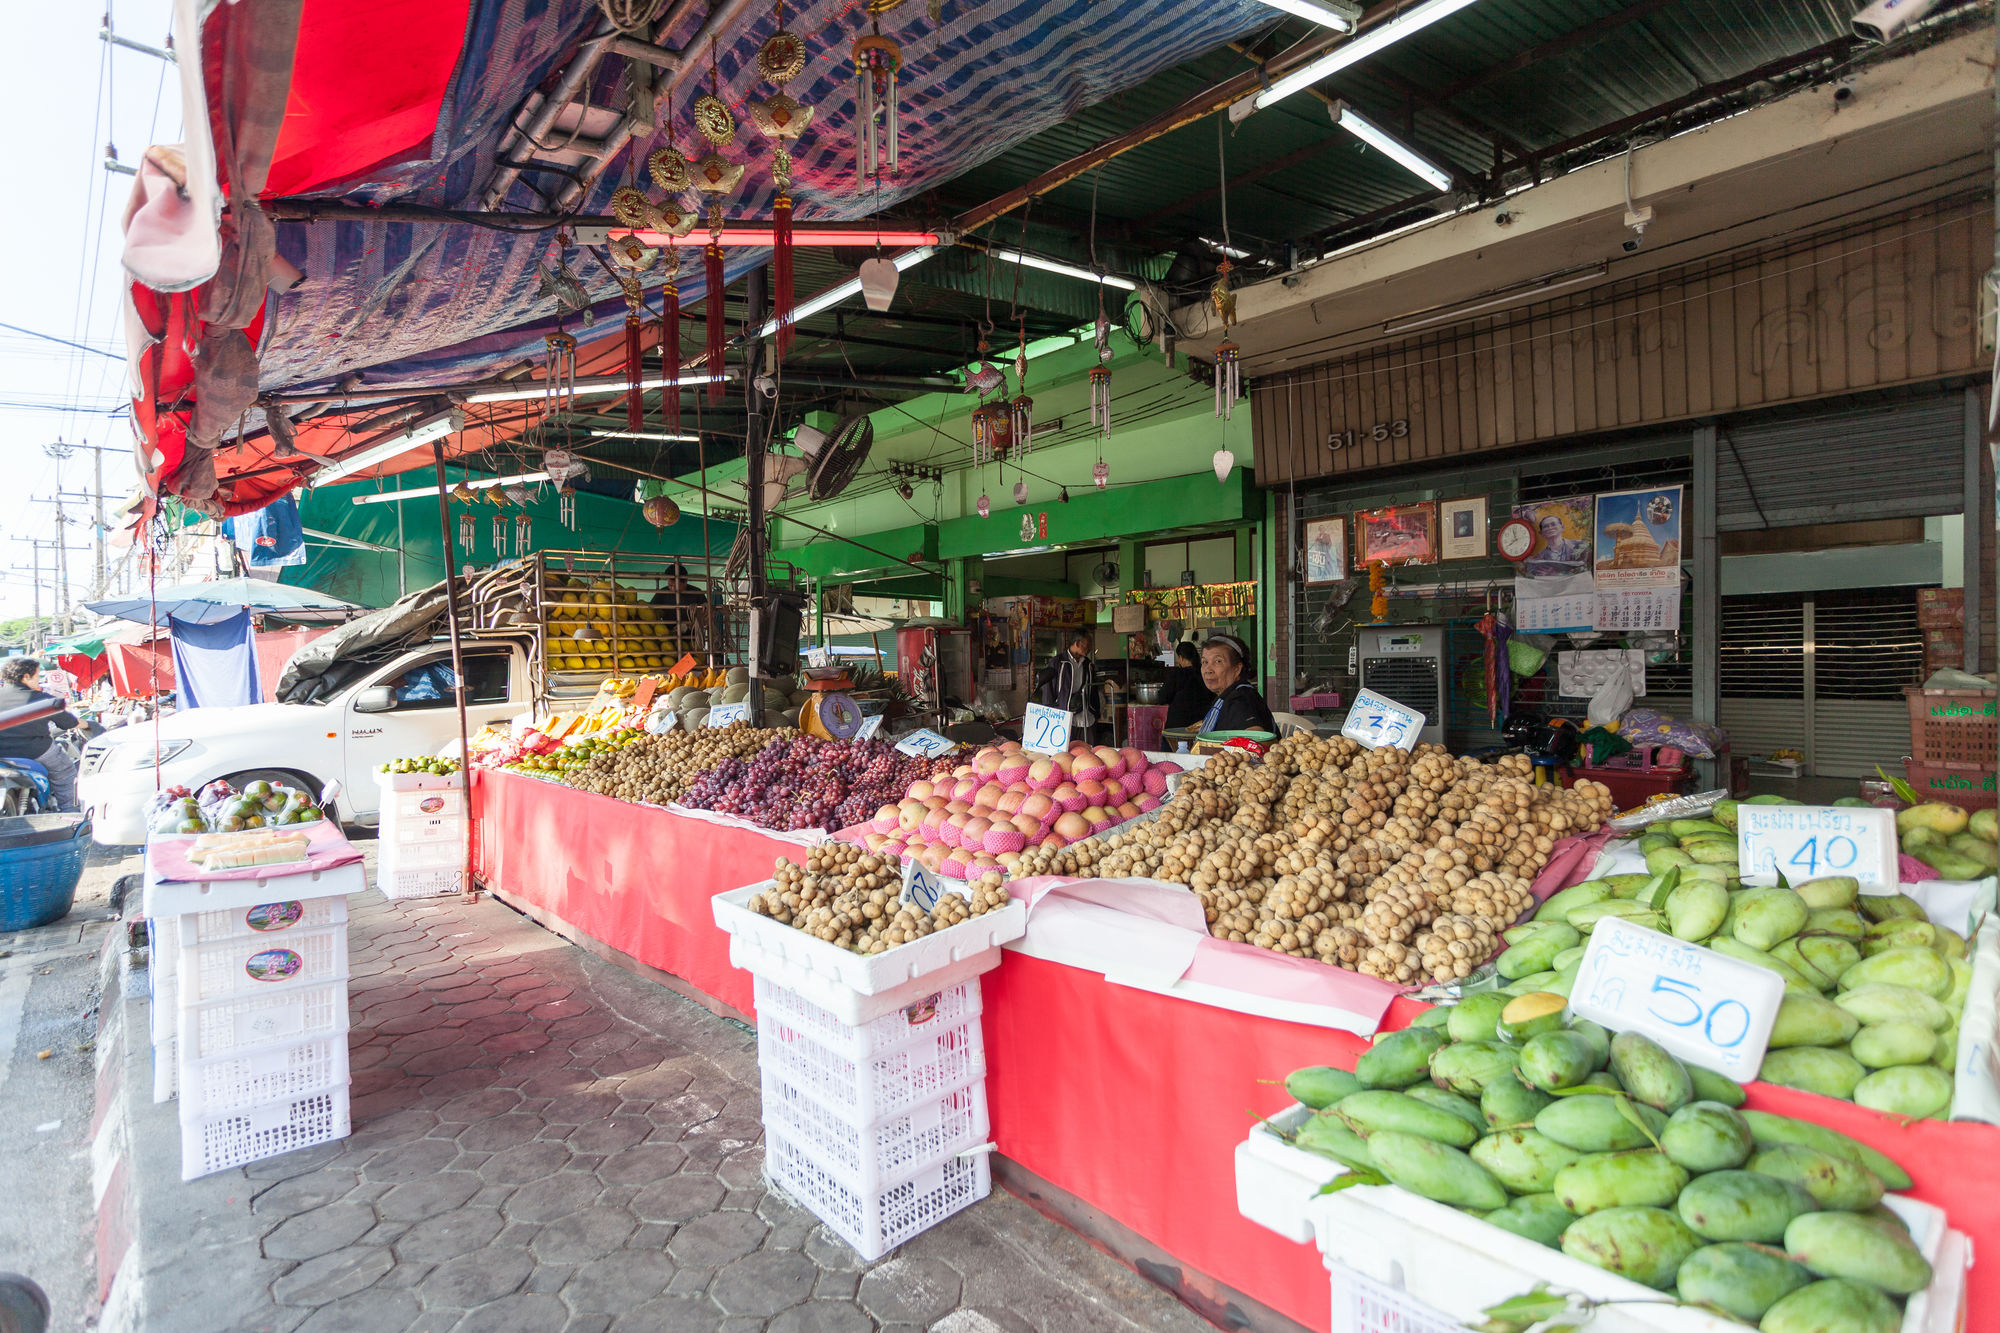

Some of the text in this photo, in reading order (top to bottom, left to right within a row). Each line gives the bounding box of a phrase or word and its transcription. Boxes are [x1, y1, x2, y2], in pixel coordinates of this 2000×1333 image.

[1327, 420, 1408, 450] 51-53
[910, 736, 941, 751] 100
[1035, 716, 1067, 749] 20
[1368, 716, 1407, 745] 35
[1788, 834, 1858, 876] 40
[1648, 974, 1751, 1048] 50
